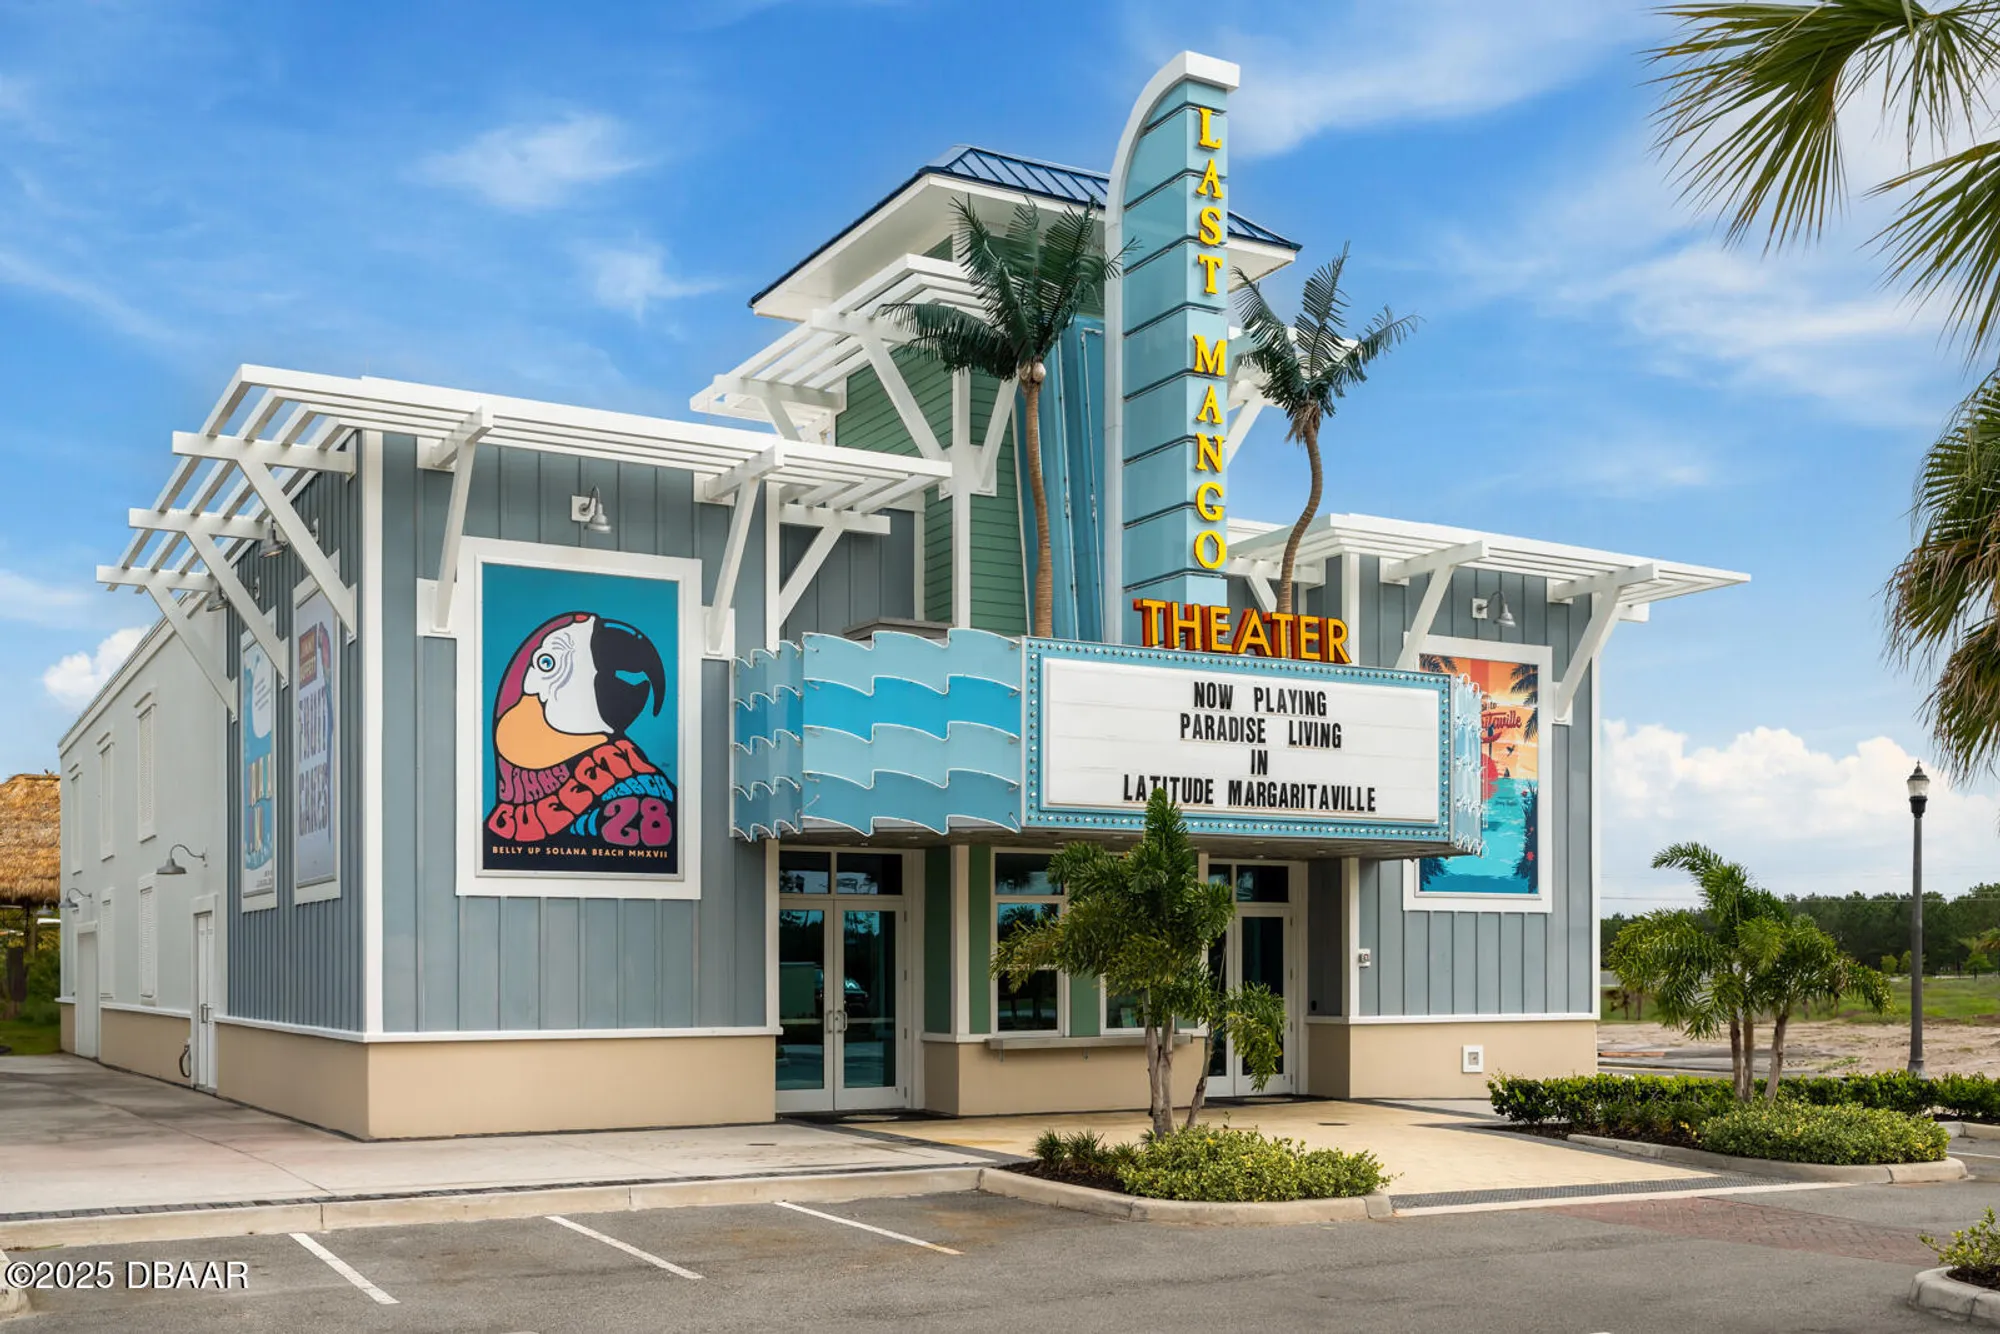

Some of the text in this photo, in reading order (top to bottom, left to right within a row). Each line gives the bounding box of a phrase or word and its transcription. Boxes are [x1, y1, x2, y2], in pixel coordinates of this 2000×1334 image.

[1193, 107, 1227, 571] LAST MANGO
[1133, 598, 1351, 664] THEATER
[1193, 681, 1327, 717] NOW PLAYING
[1179, 713, 1342, 748] PARADISE LIVING
[1250, 749, 1268, 775] IN
[499, 757, 570, 804] JIMMY
[1228, 780, 1376, 812] MARGARITAVILLE
[601, 796, 673, 847] 28
[492, 846, 668, 859] BELLY UP SOLANA BEACH MMXVII
